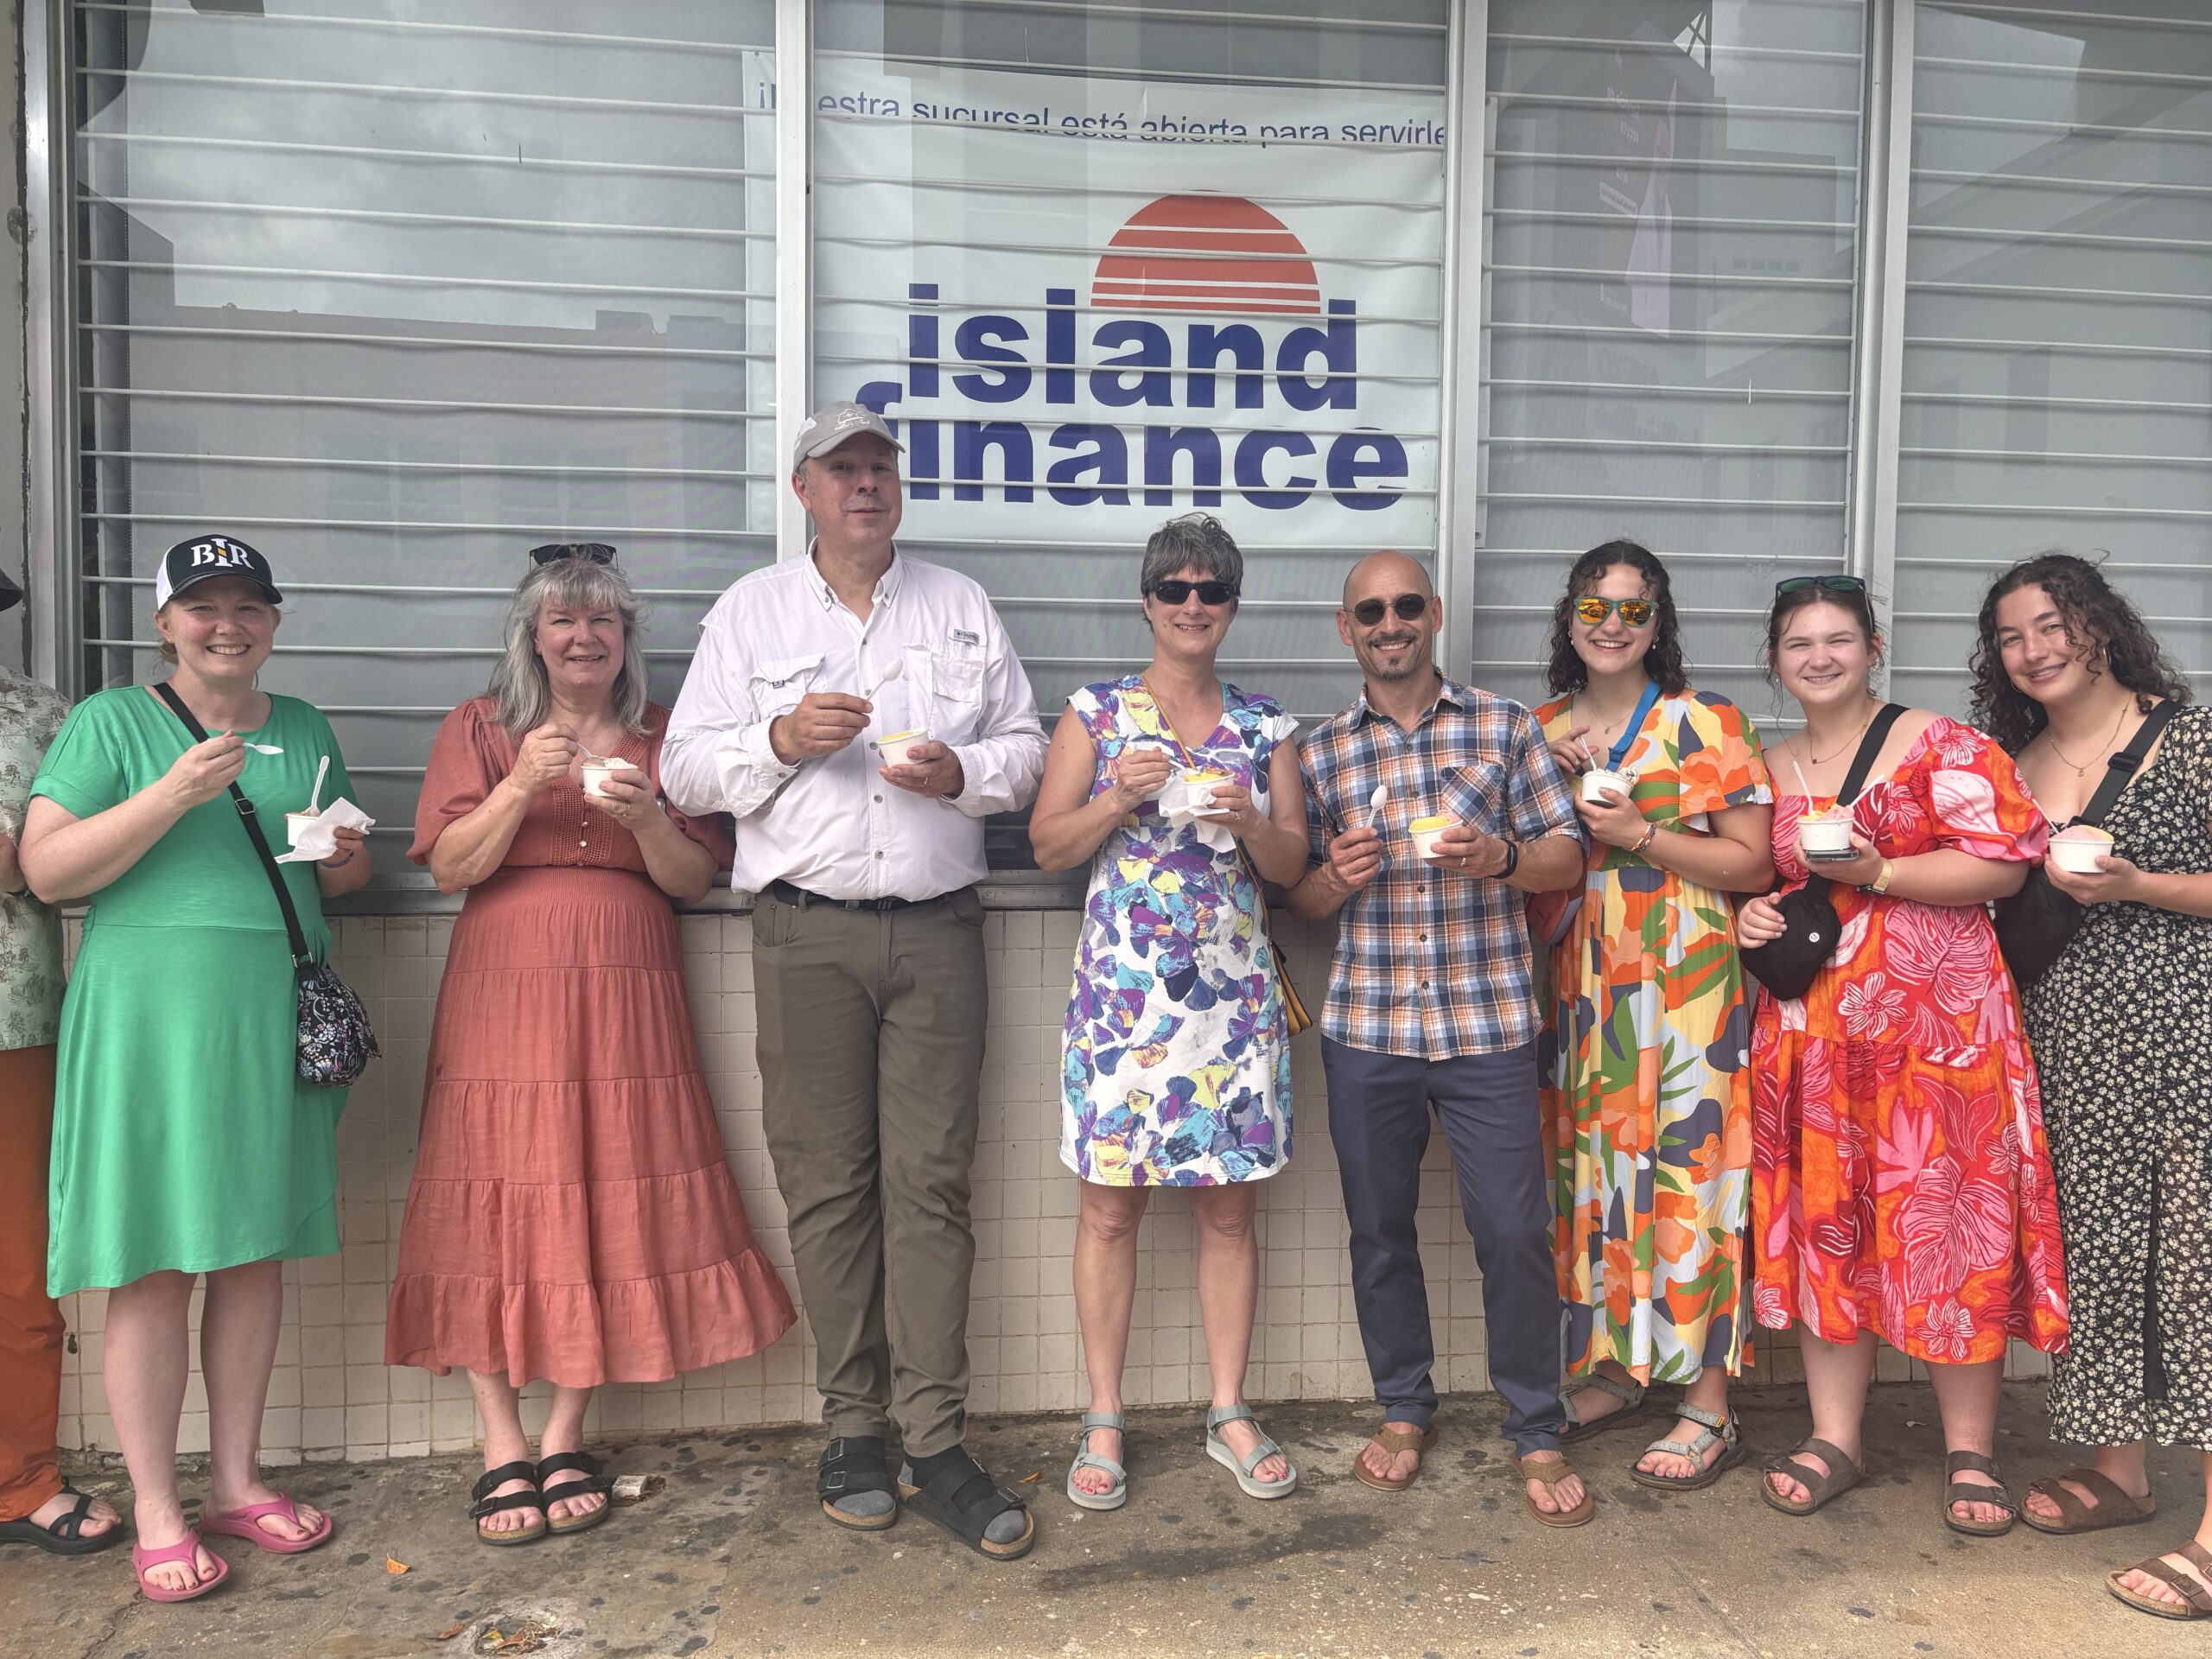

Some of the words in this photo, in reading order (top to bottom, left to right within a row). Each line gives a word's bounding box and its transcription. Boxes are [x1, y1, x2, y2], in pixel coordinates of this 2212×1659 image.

[760, 82, 899, 120] ¡estra
[912, 103, 1049, 134] sucursal
[1061, 113, 1128, 141] está
[1140, 115, 1248, 143] abierta
[1260, 123, 1329, 149] para
[1341, 119, 1444, 145] servirle
[909, 283, 1357, 411] island
[190, 537, 255, 570] BIR
